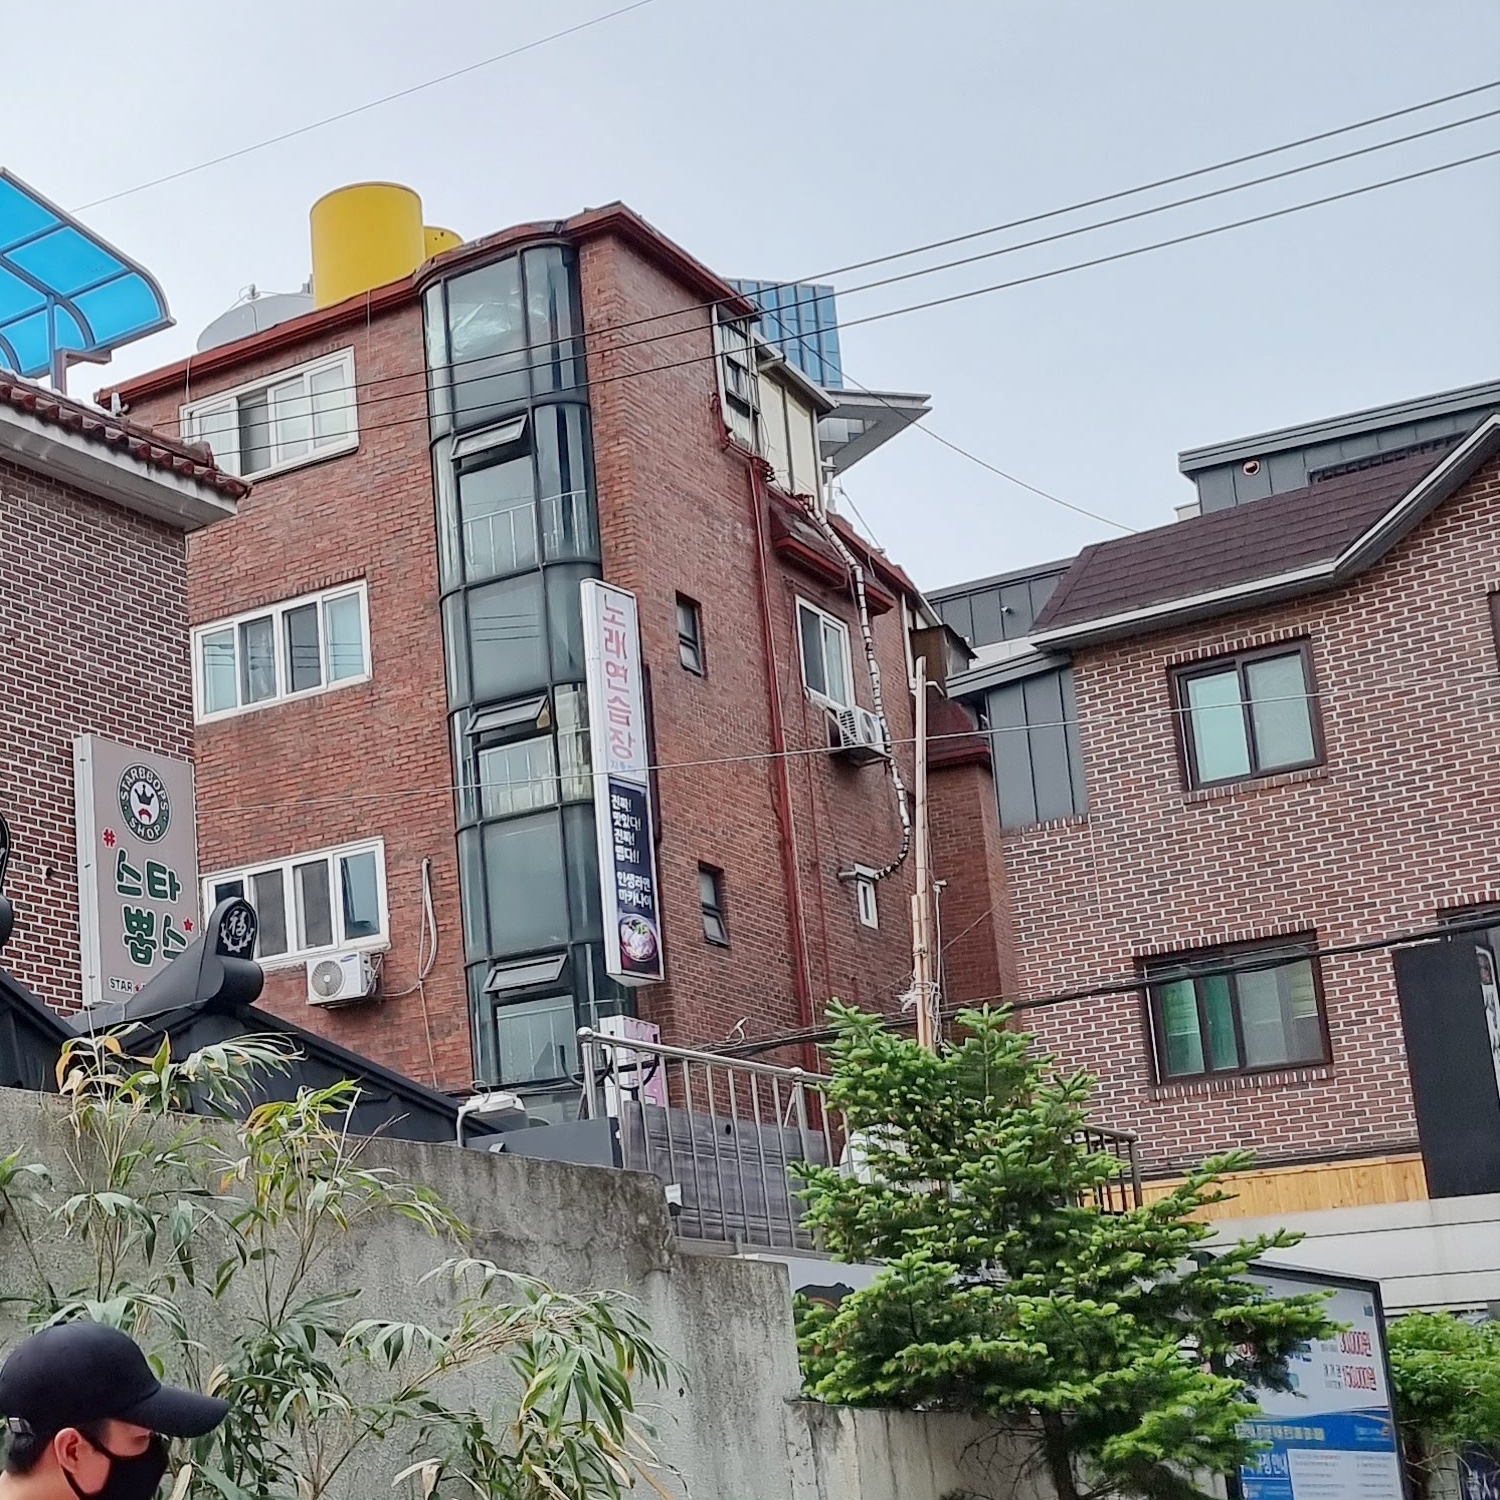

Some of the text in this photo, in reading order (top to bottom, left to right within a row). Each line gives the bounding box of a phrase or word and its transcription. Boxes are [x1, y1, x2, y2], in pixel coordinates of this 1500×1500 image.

[602, 593, 637, 760] 노래연습장
[120, 767, 169, 811] STARBBOPS
[129, 817, 161, 839] SHOP
[612, 811, 641, 831] 맛있다!
[116, 849, 181, 902] 스타
[109, 977, 133, 993] STAR
